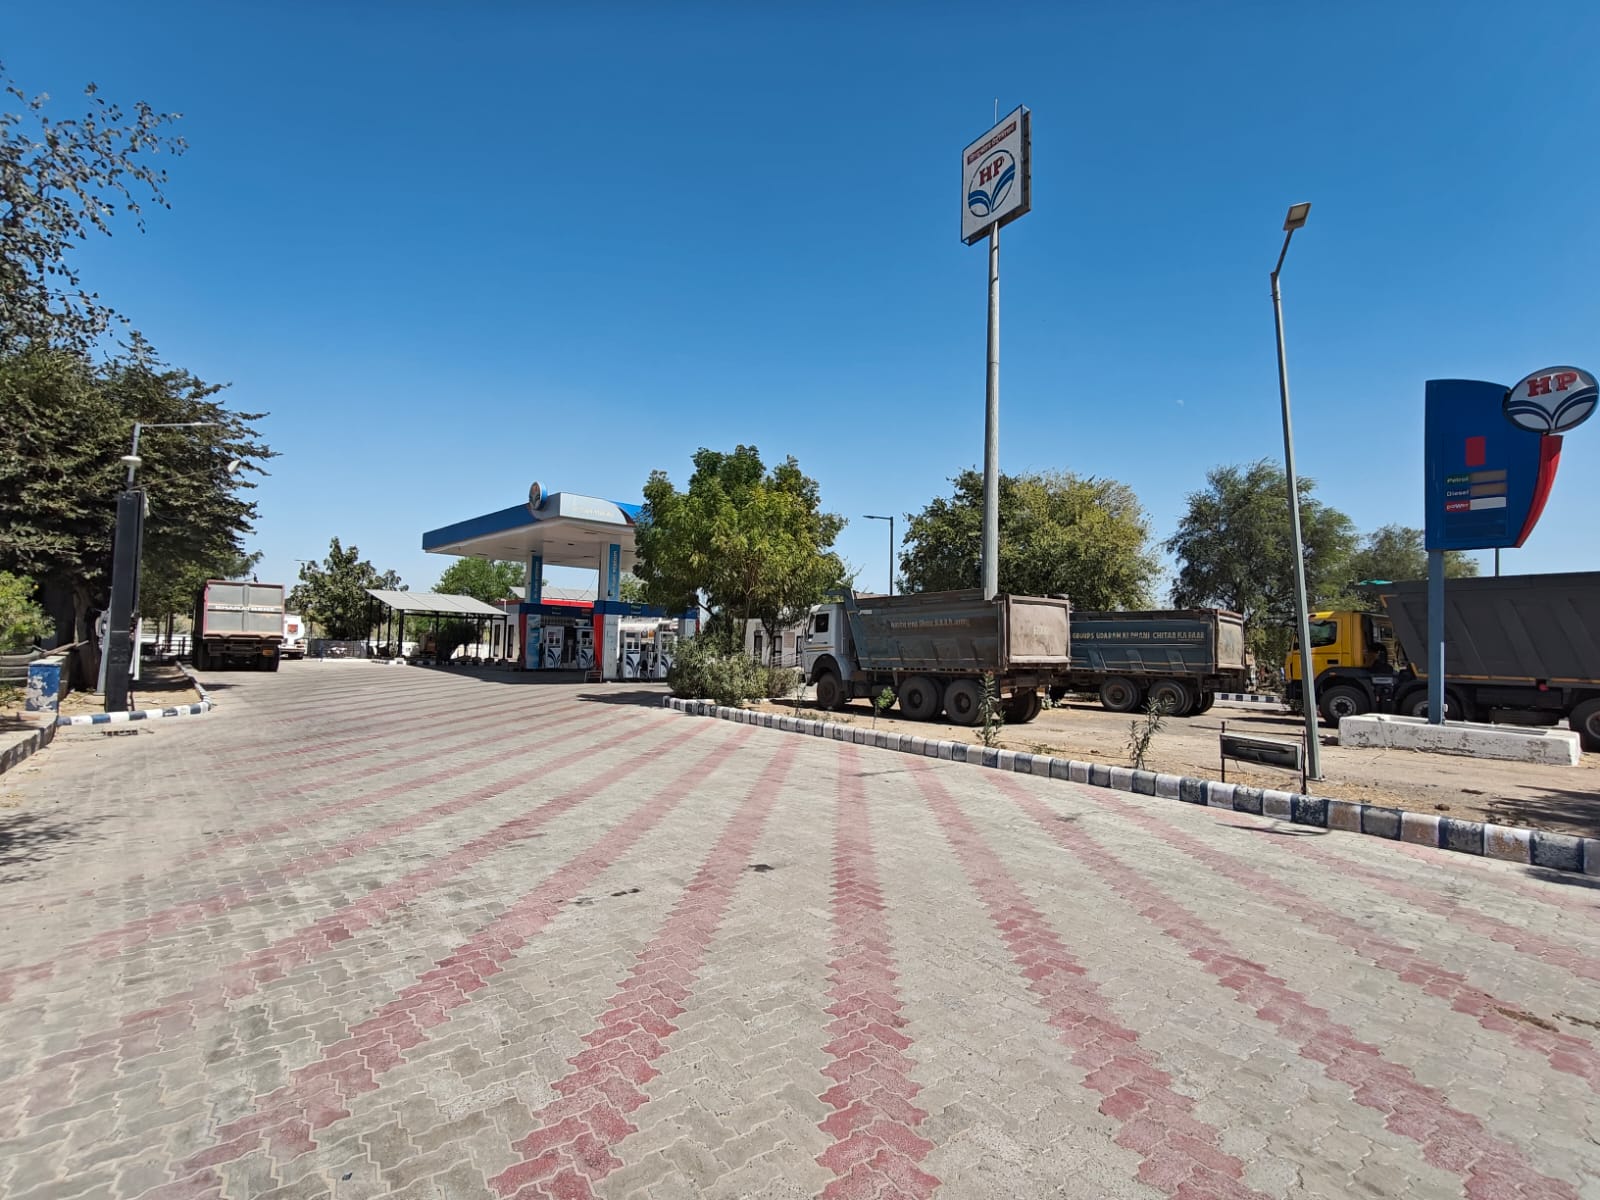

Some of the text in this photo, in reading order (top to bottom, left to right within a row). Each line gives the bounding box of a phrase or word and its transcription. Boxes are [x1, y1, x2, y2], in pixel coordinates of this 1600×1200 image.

[979, 156, 1005, 186] HP
[1527, 371, 1577, 397] HP
[1446, 475, 1469, 484] Petrol
[1446, 488, 1470, 497] Diesel
